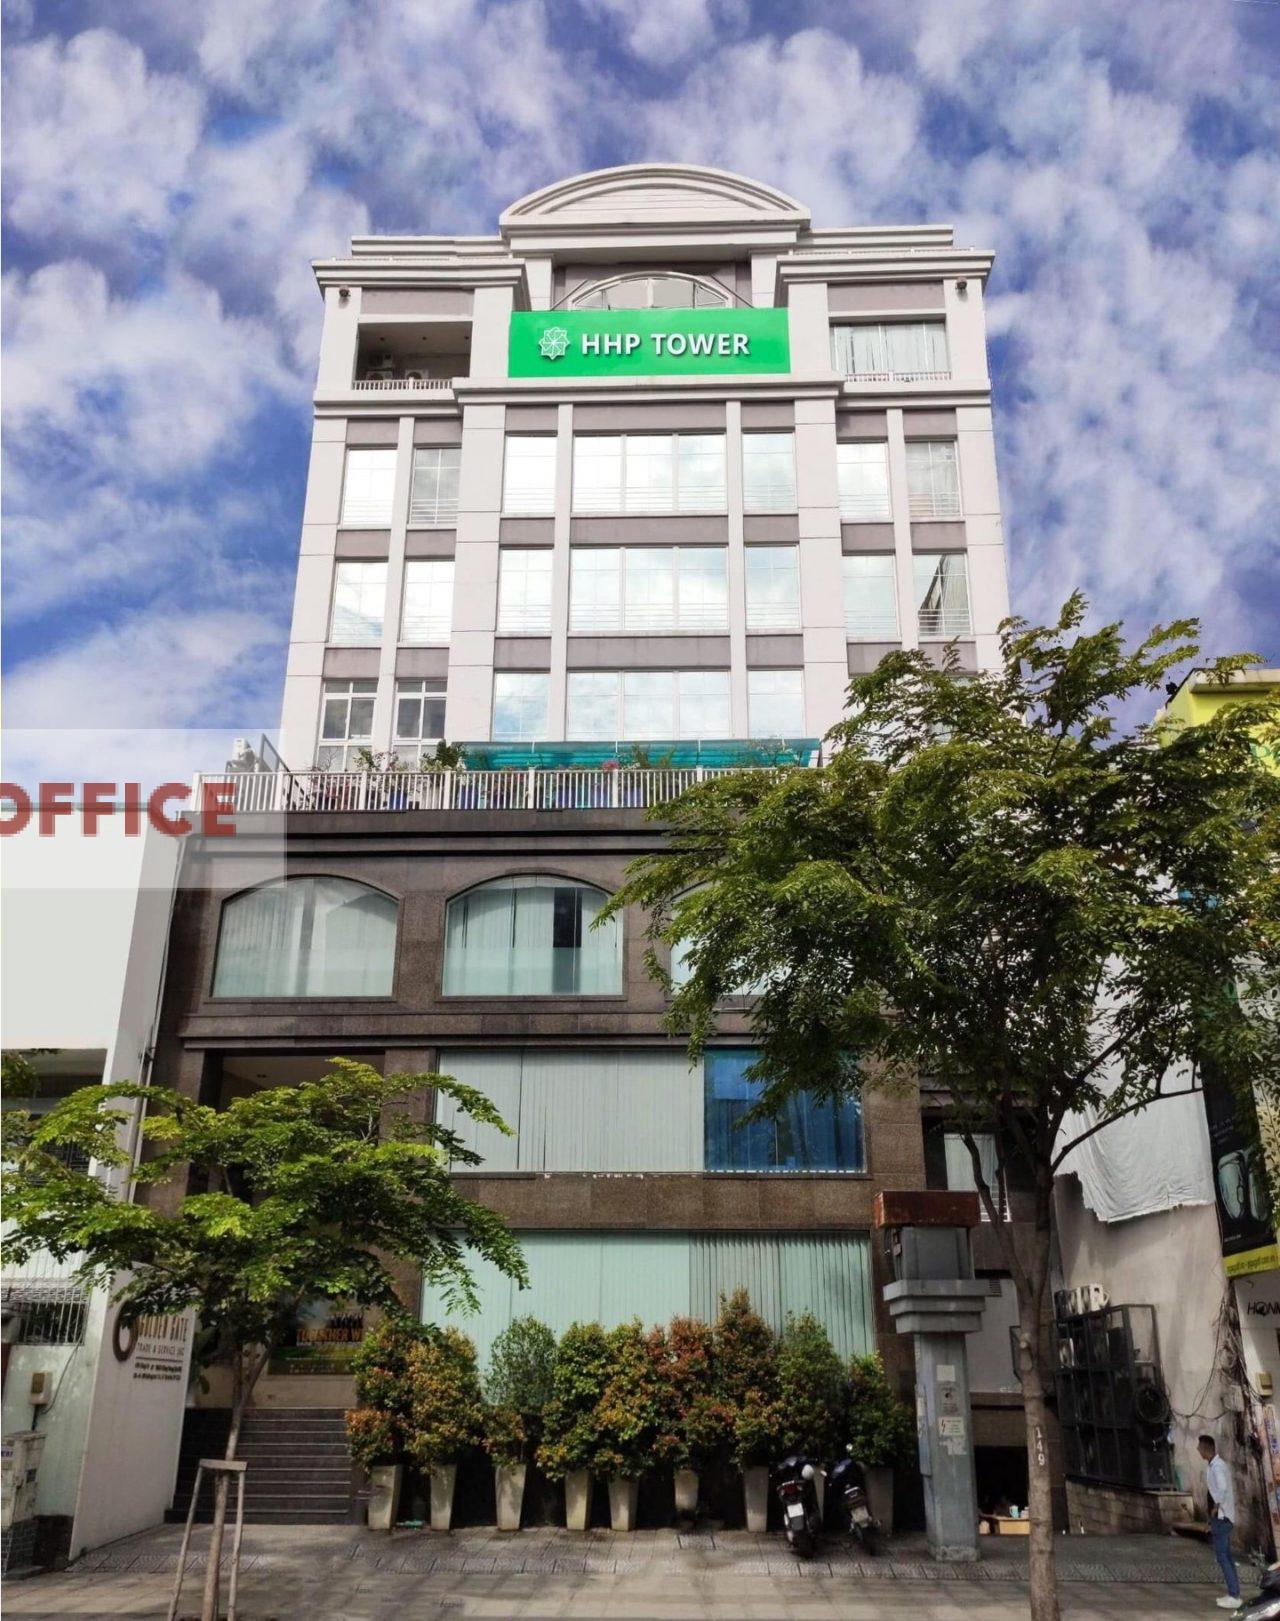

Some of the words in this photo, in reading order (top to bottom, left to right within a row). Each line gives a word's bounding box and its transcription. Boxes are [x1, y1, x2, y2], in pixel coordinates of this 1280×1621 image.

[581, 333, 641, 355] HHP
[650, 332, 750, 355] TOWER
[1035, 1426, 1045, 1466] 149
